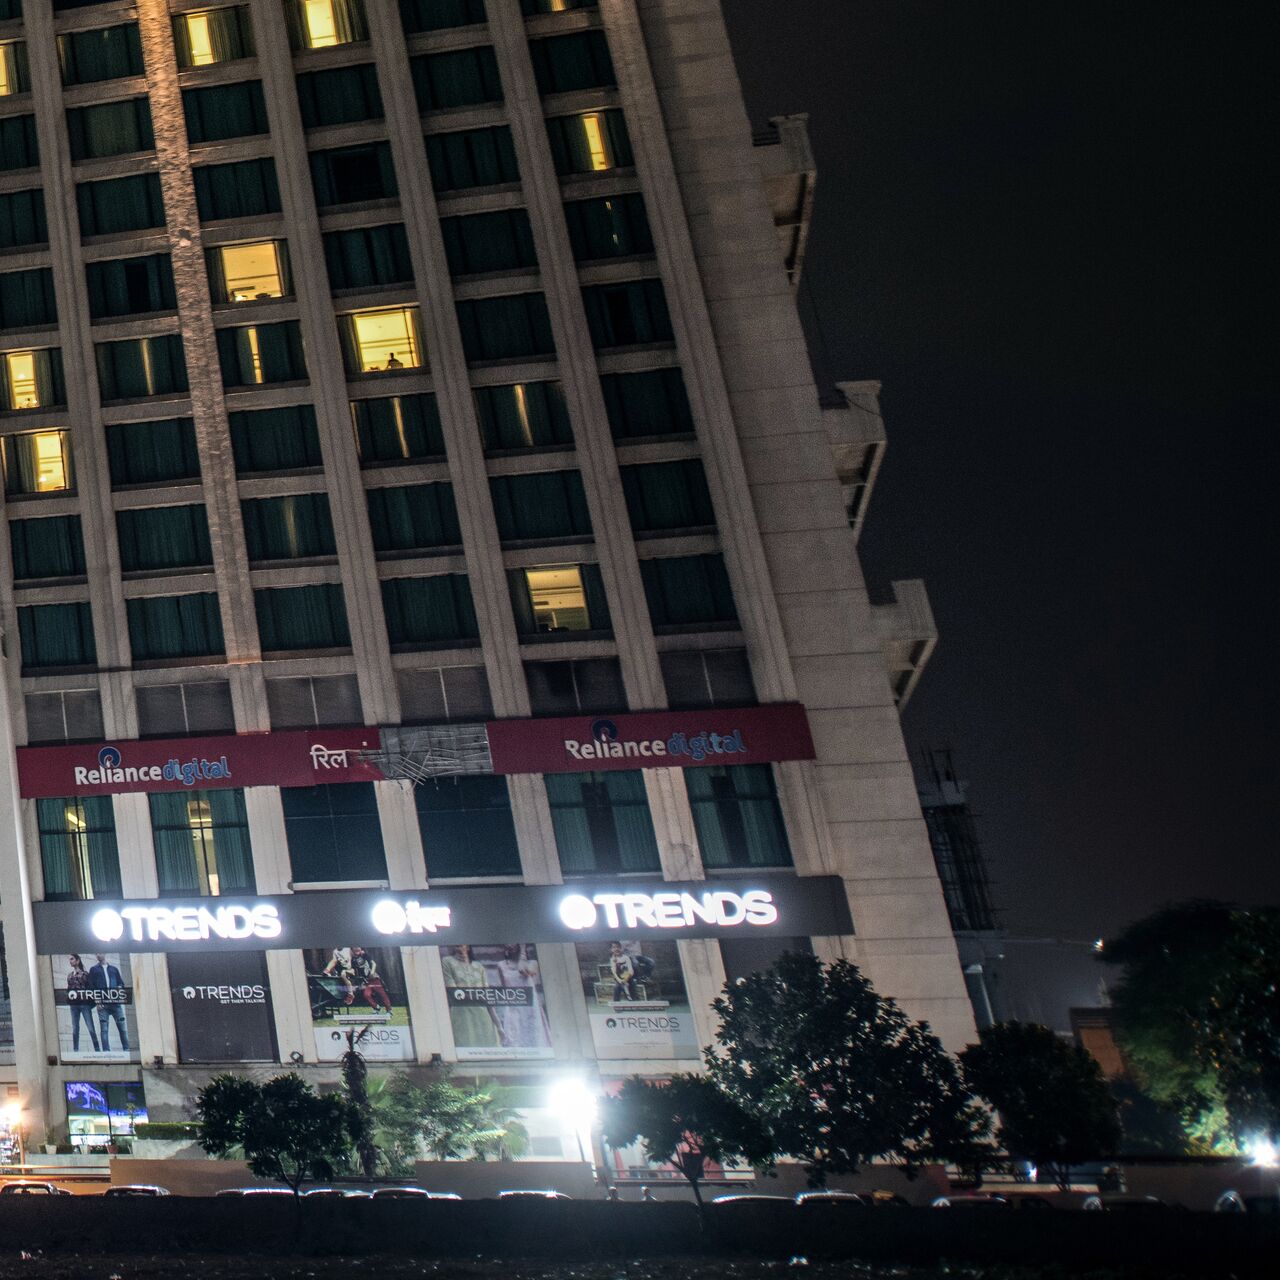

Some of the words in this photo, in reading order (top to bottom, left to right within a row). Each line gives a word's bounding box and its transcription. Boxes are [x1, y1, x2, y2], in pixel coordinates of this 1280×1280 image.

[564, 733, 667, 759] Reliance
[667, 729, 747, 760] digital
[74, 761, 162, 785] Reliance
[162, 756, 231, 785] digital
[593, 890, 778, 928] TRENDS
[120, 904, 282, 941] TRENDS
[77, 989, 128, 1000] TRENDS
[195, 985, 265, 1000] TRENDS
[465, 988, 527, 1001] TRENDS
[616, 1017, 680, 1029] TRENDS
